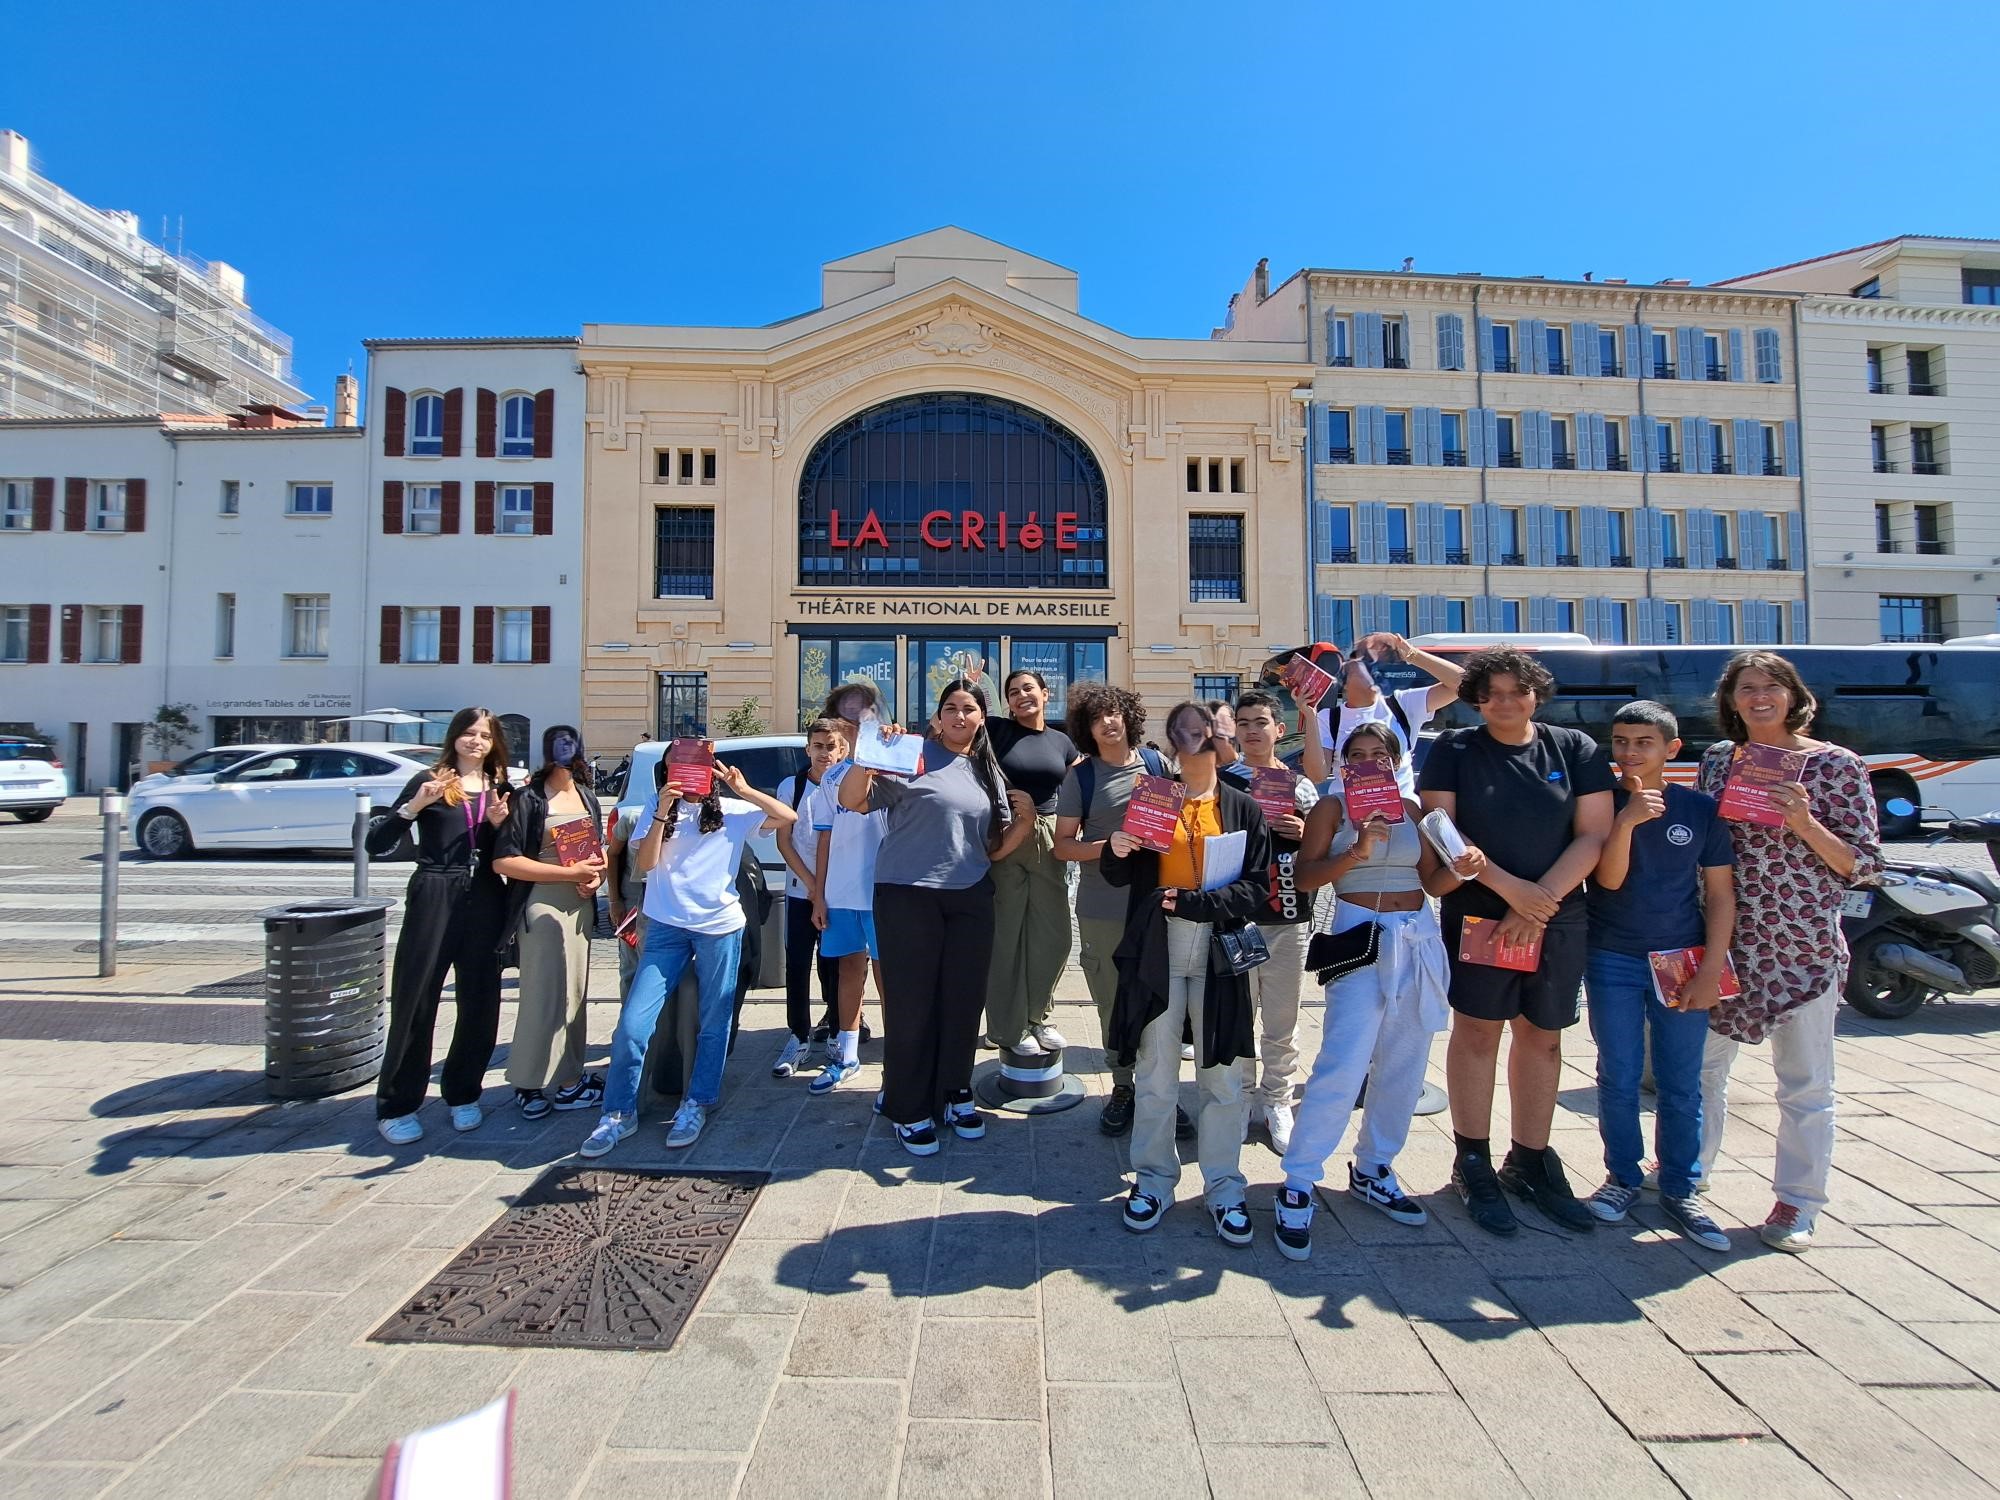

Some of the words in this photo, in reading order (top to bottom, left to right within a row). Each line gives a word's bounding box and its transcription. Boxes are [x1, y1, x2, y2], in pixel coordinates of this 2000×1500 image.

[857, 355, 912, 377] LIBRE
[1031, 367, 1112, 418] POISSONS
[831, 508, 889, 548] LA
[921, 509, 1078, 549] CRIéE
[797, 597, 876, 615] THÉÂTRE
[883, 602, 981, 616] NATIONAL
[987, 602, 1010, 616] DE
[1016, 603, 1110, 617] MARSEILLE
[263, 700, 294, 708] Tables
[298, 700, 310, 708] de
[1136, 805, 1148, 813] FORÊT
[1277, 852, 1298, 919] adidas
